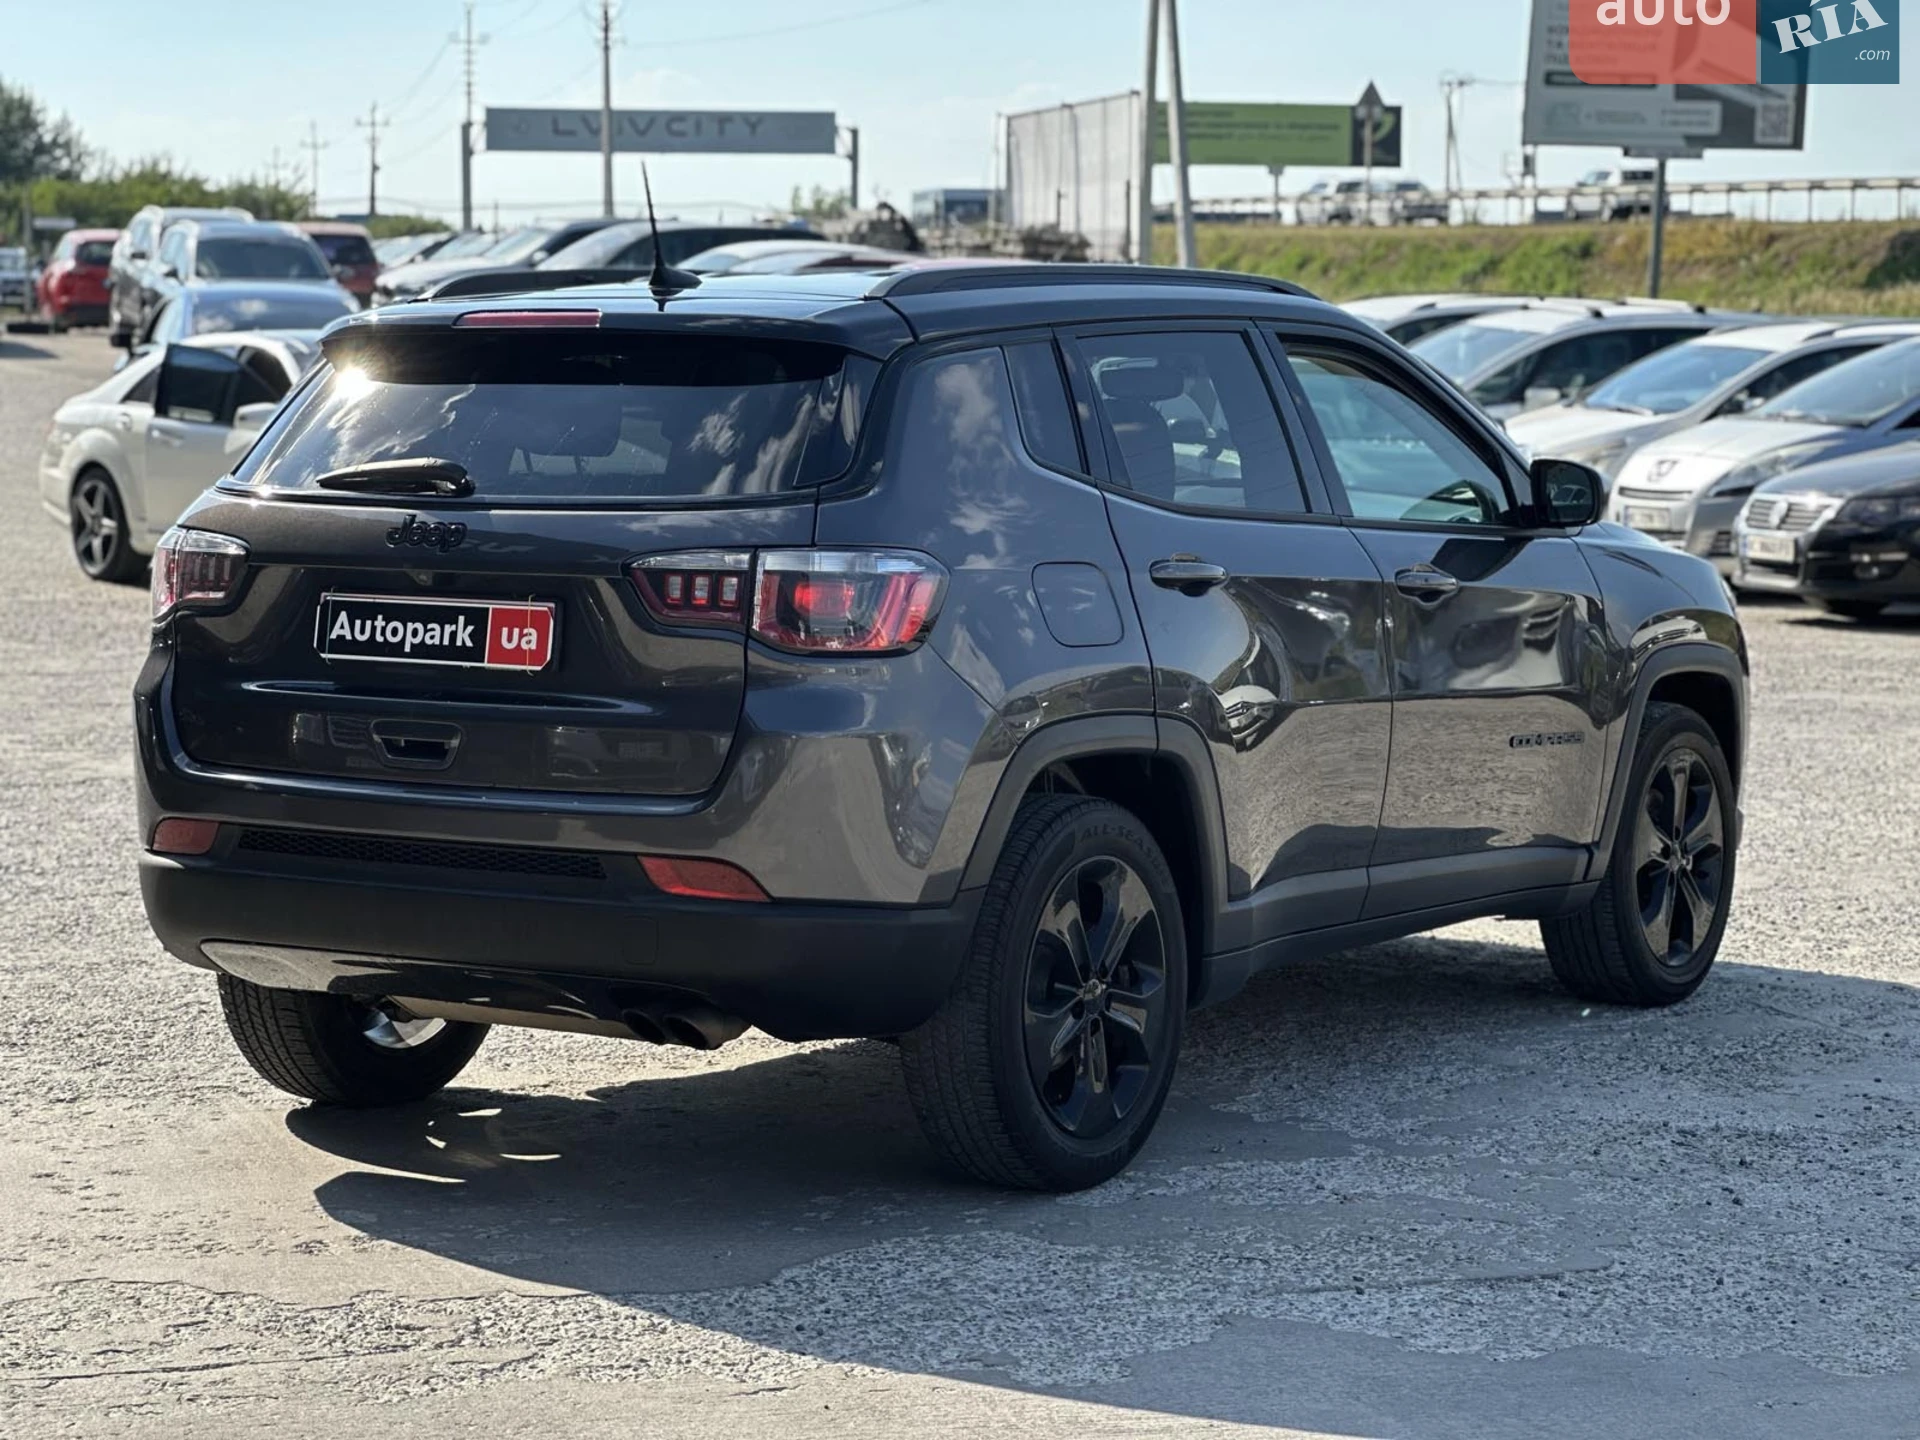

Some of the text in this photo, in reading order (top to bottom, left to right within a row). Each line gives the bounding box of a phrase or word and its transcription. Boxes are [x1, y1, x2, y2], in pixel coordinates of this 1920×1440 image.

[385, 514, 468, 554] Jeep
[329, 610, 538, 653] Autopark ua
